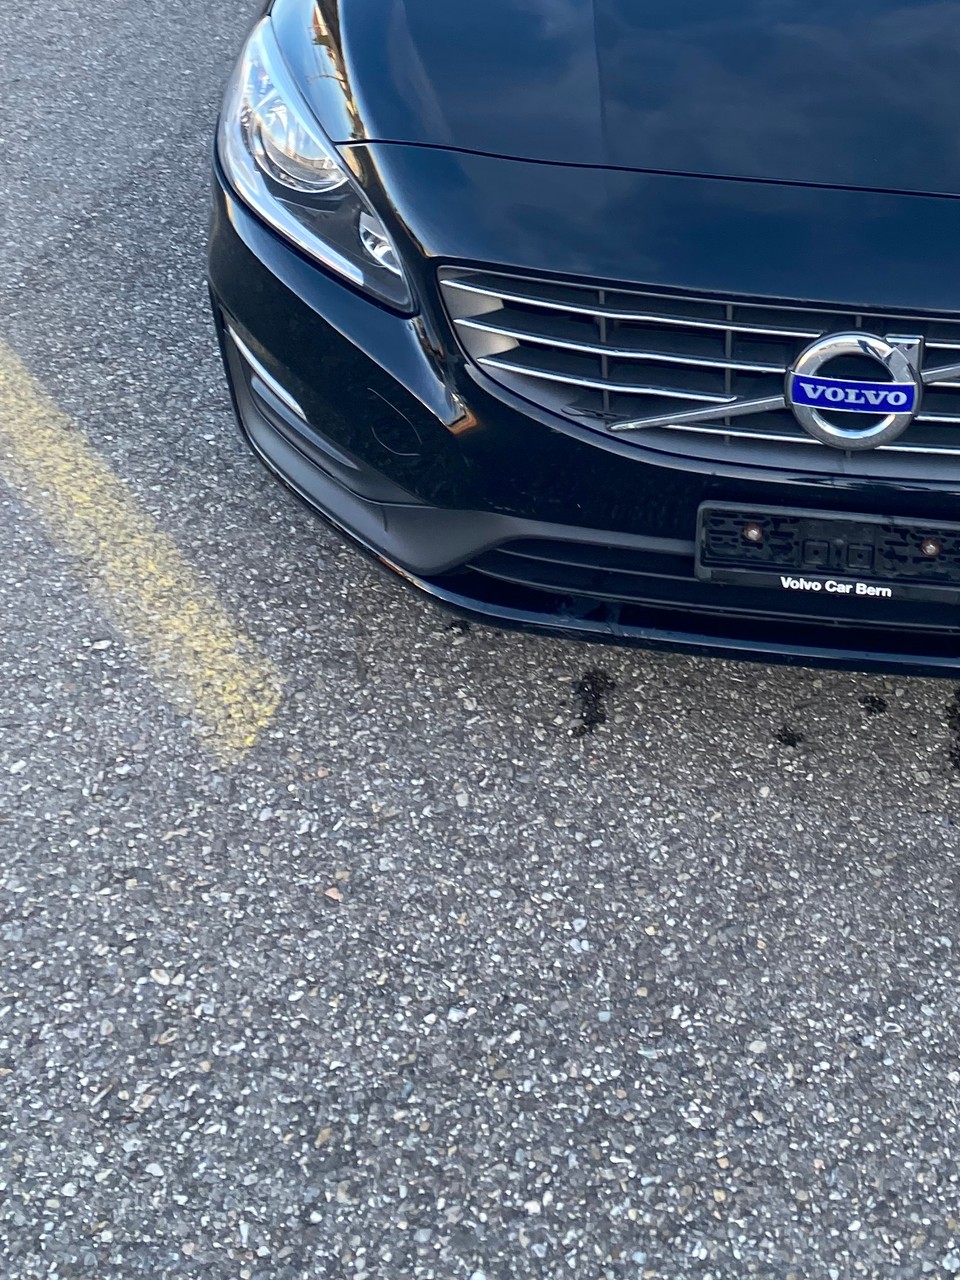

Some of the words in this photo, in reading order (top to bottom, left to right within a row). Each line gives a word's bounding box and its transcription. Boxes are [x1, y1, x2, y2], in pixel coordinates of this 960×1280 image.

[799, 382, 908, 406] VOLVO
[780, 576, 822, 591] Volvo
[824, 580, 853, 594] Car
[855, 582, 892, 597] Bern
